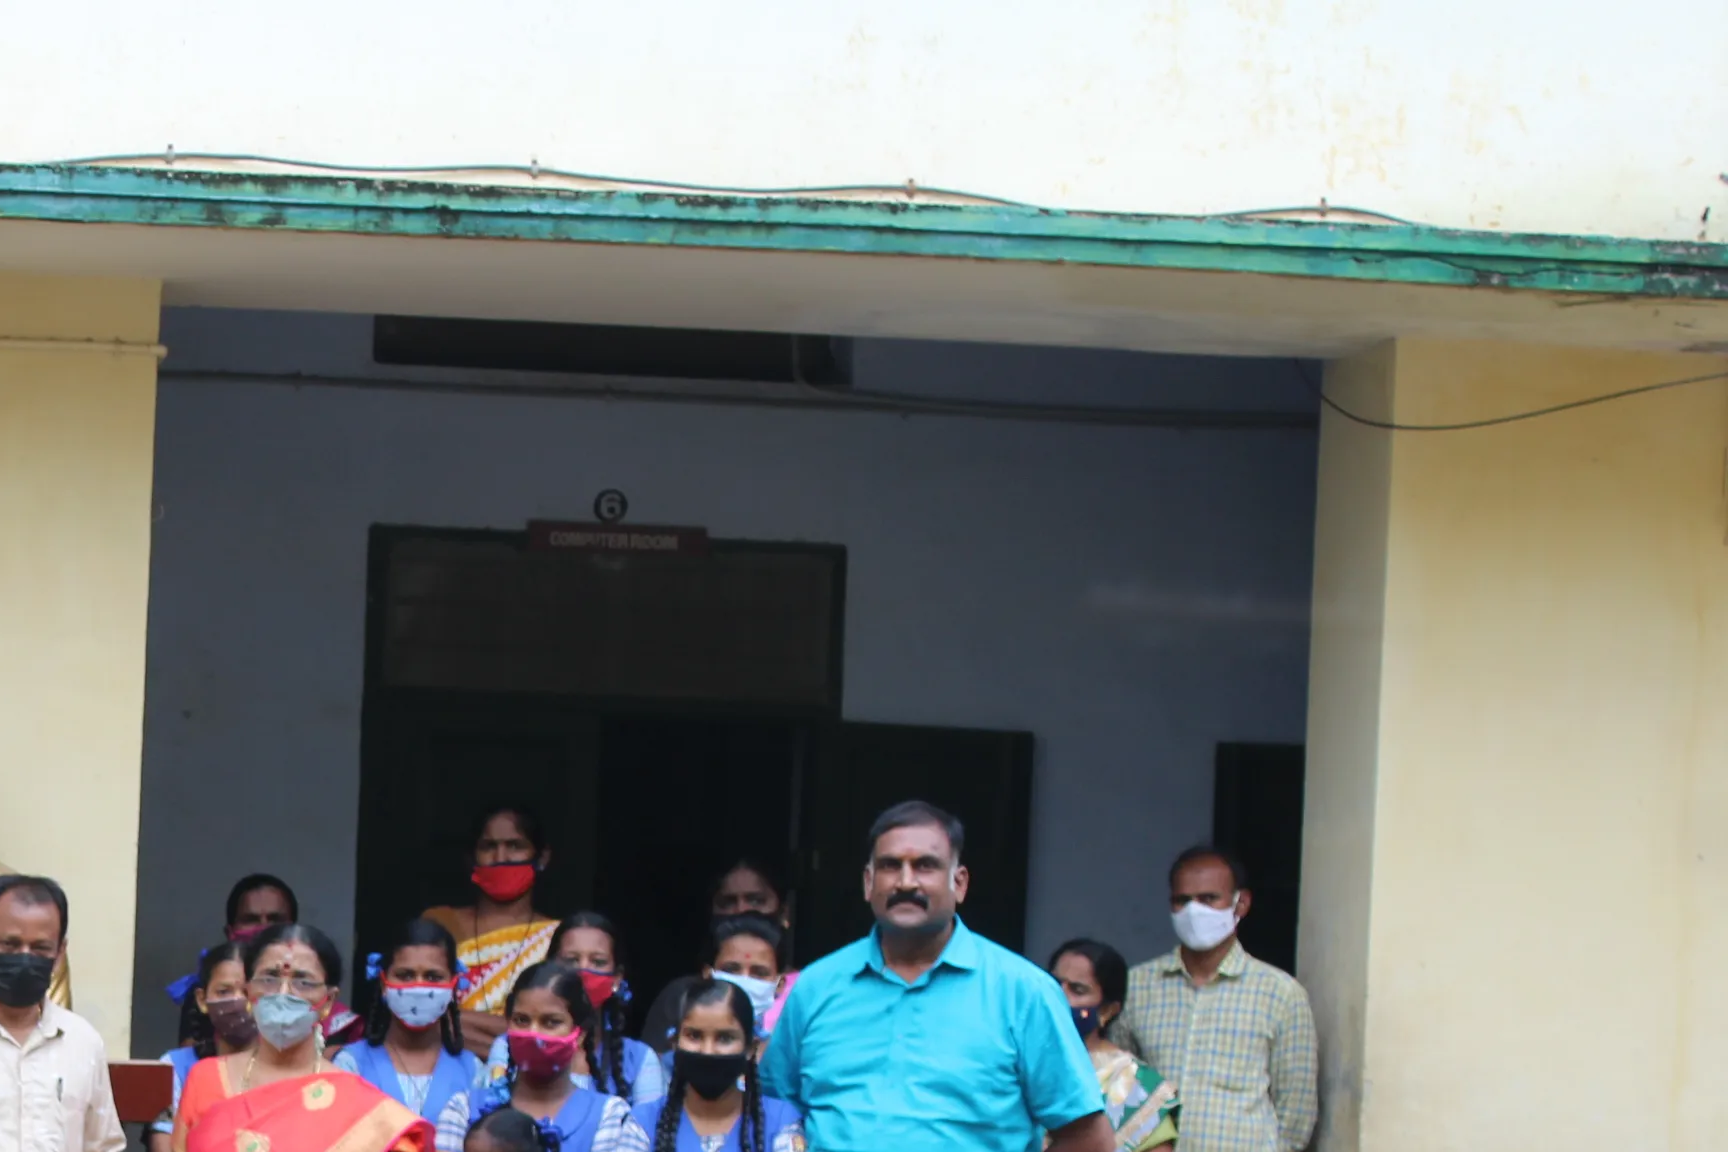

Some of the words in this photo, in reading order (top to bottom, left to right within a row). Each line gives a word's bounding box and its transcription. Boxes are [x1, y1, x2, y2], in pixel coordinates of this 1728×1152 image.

[599, 494, 622, 520] 6
[549, 531, 628, 549] COMPUTER
[630, 533, 678, 550] ROOM
